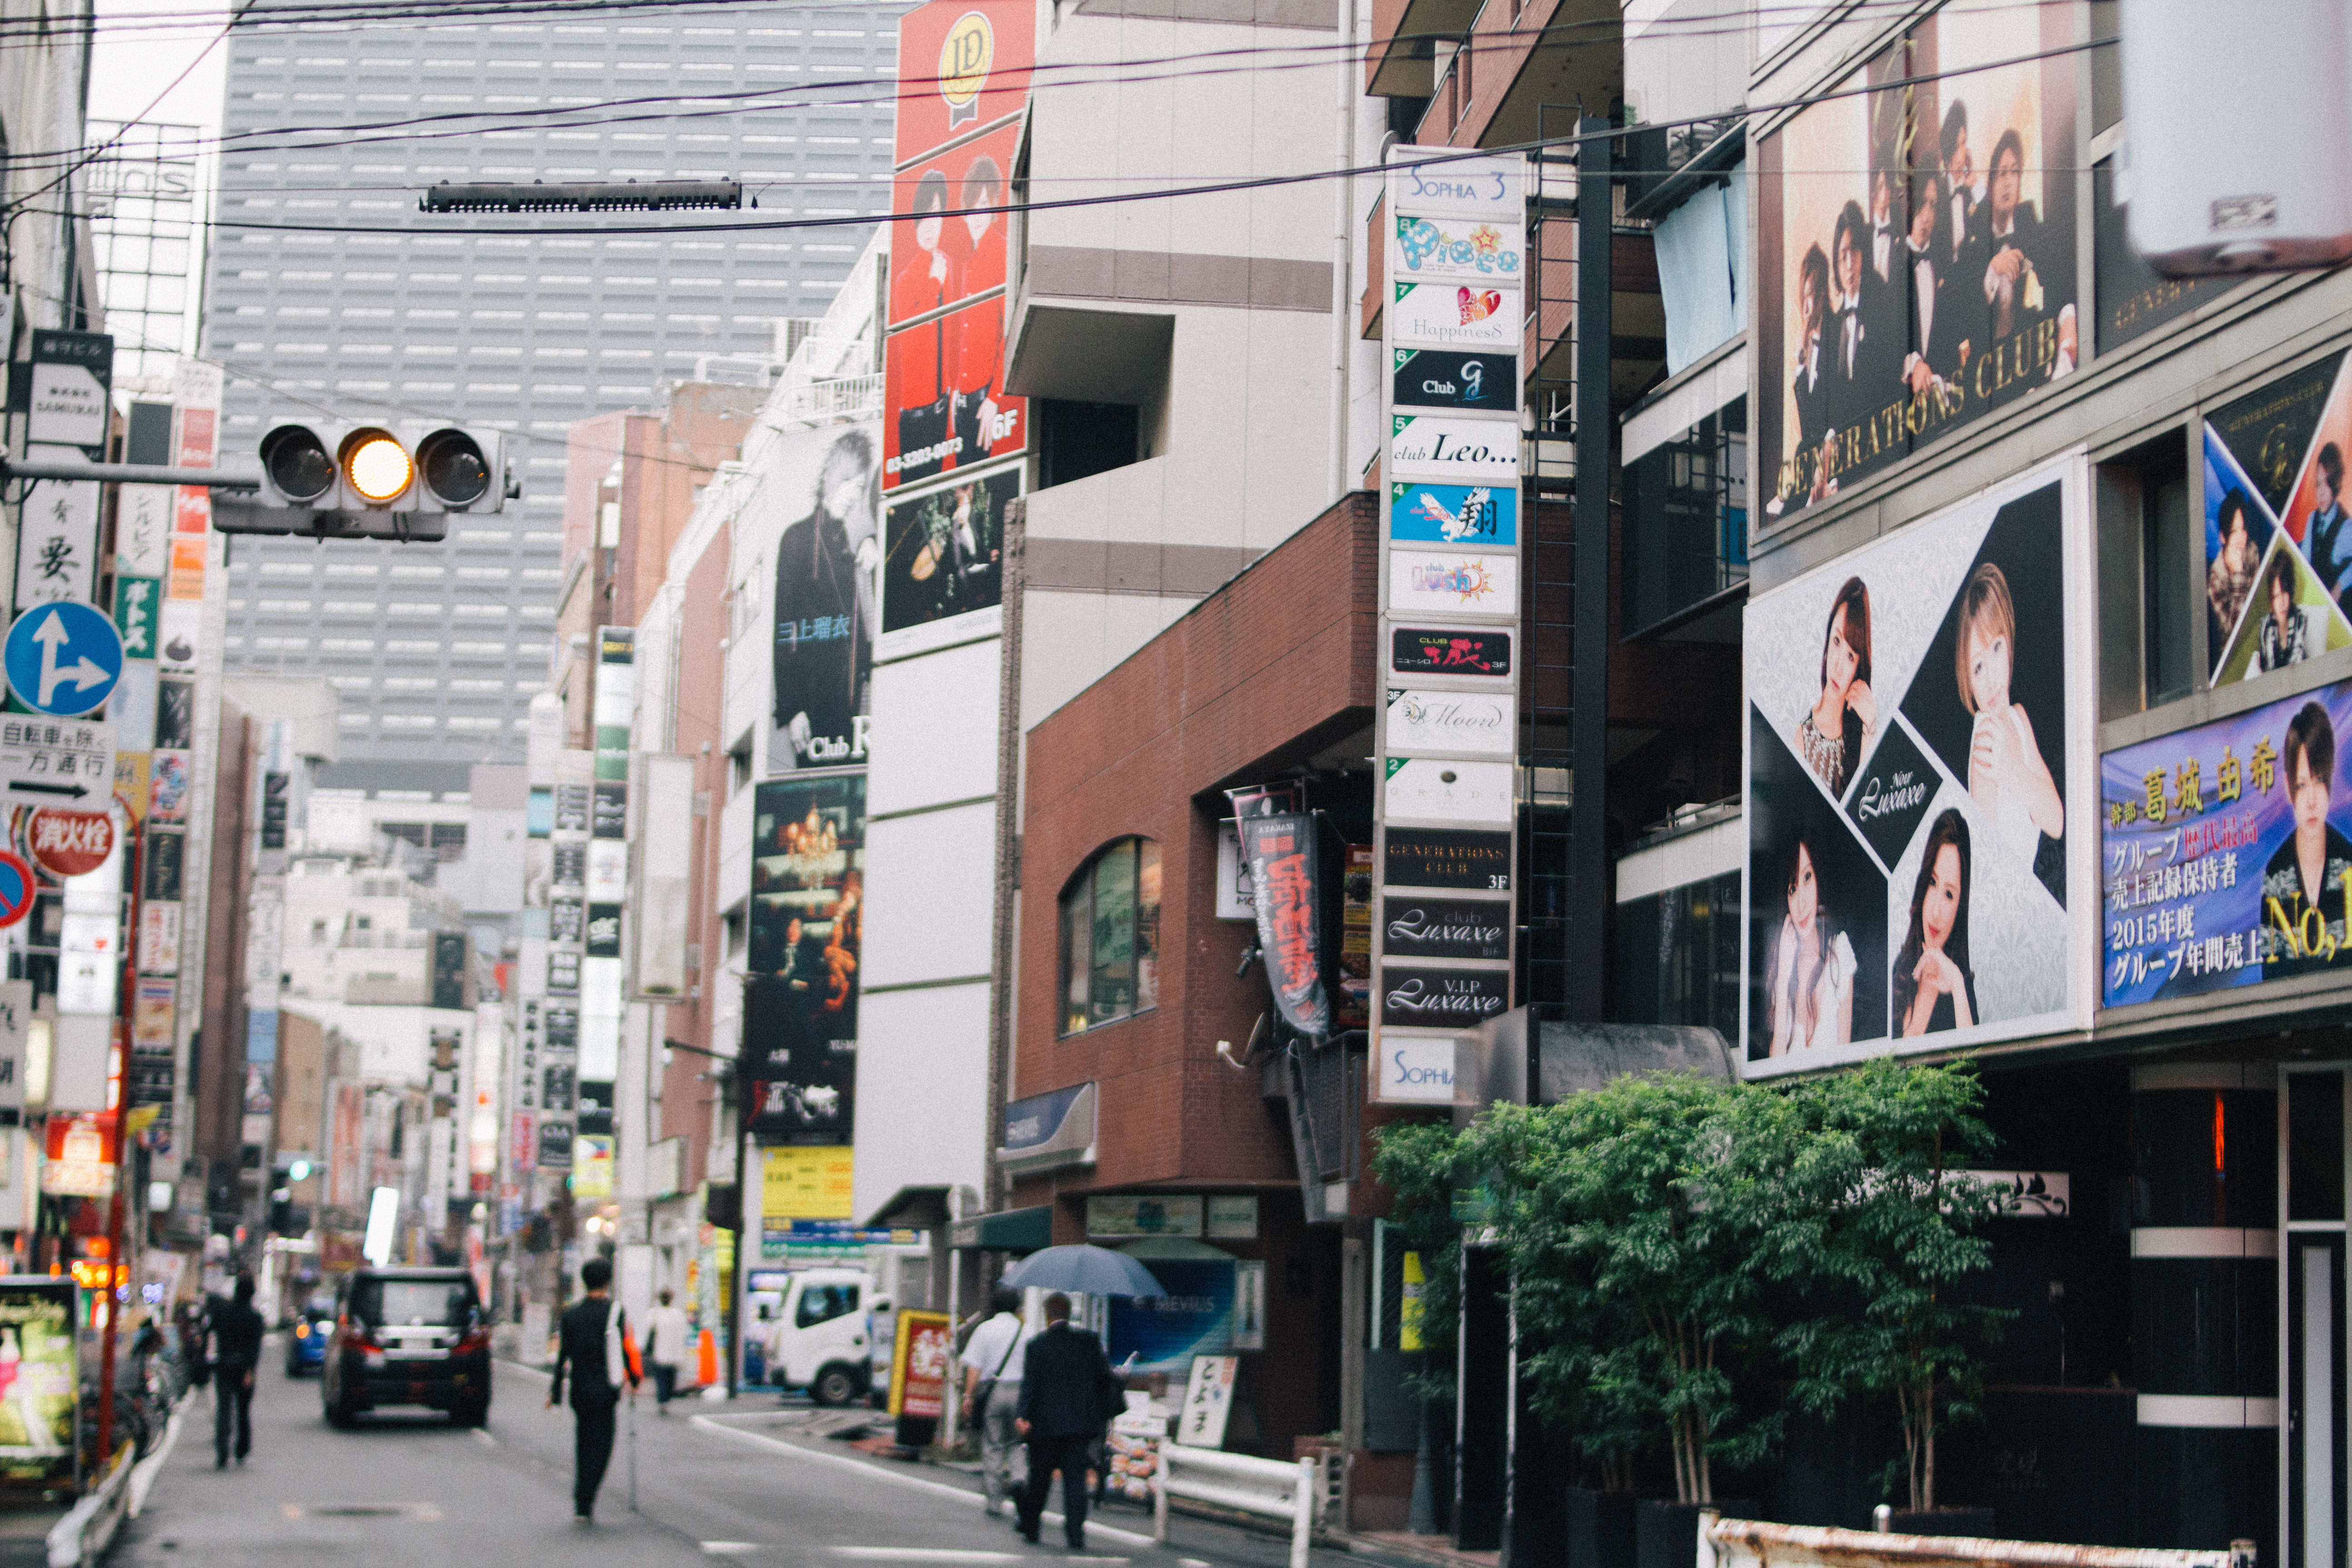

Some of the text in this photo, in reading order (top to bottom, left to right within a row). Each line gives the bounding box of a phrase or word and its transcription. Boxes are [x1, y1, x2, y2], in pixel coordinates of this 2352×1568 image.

[1411, 165, 1505, 200] SOPHIA 3
[1398, 284, 1409, 296] 7
[1396, 349, 1407, 362] 6
[1422, 379, 1456, 395] Club
[1777, 318, 2056, 503] GENERATIONS CLUB
[991, 409, 1018, 441] 6F
[1395, 417, 1406, 430] 5
[1394, 446, 1426, 460] club
[1393, 483, 1405, 495] 4
[1459, 490, 1497, 536] 翔
[1426, 563, 1445, 573] club
[1411, 565, 1472, 593] Lush
[1387, 690, 1400, 700] 3F
[3, 722, 107, 747] 自転車を除く
[807, 735, 850, 761] Club
[2, 749, 106, 777] 一方通行
[1389, 759, 1399, 770] 2
[2217, 735, 2278, 803] 由希
[1390, 788, 1507, 800] GRADE
[35, 816, 111, 855] 消火栓
[1426, 862, 1468, 874] CLUB
[1488, 875, 1507, 890] 3F
[2112, 852, 2238, 913] 売上記録保持者
[1445, 911, 1481, 924] club
[2112, 904, 2195, 952] 2015年度
[2113, 928, 2264, 990] グループ年間売上
[1445, 980, 1480, 994] V.I.P
[1154, 1295, 1215, 1314] MEVIUS
